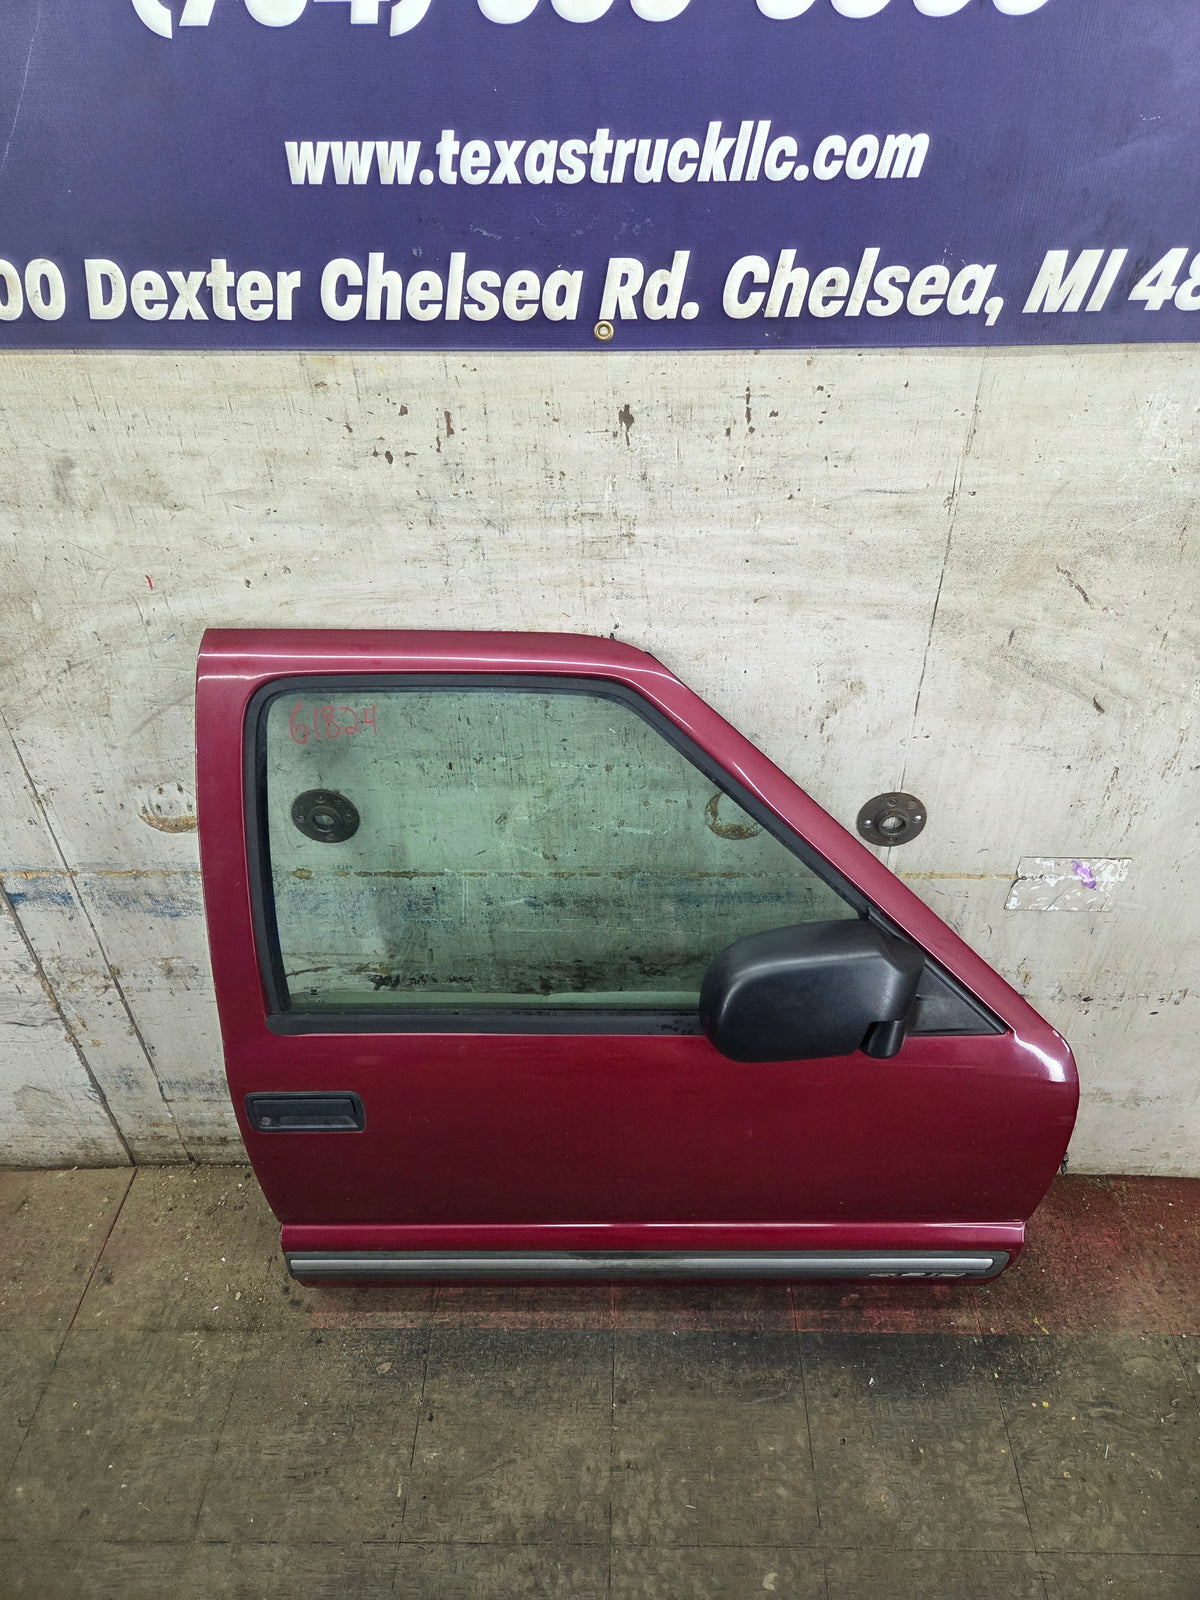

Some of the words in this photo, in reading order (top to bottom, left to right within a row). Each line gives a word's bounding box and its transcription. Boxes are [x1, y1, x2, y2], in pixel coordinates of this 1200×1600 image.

[284, 119, 931, 186] www.texastruckllc.com
[84, 258, 301, 321] Dexter
[320, 251, 584, 322] Chelsea
[598, 250, 700, 321] Rd.
[722, 247, 1005, 327] Chelsea,
[1021, 248, 1129, 314] MI
[289, 701, 378, 744] 61824
